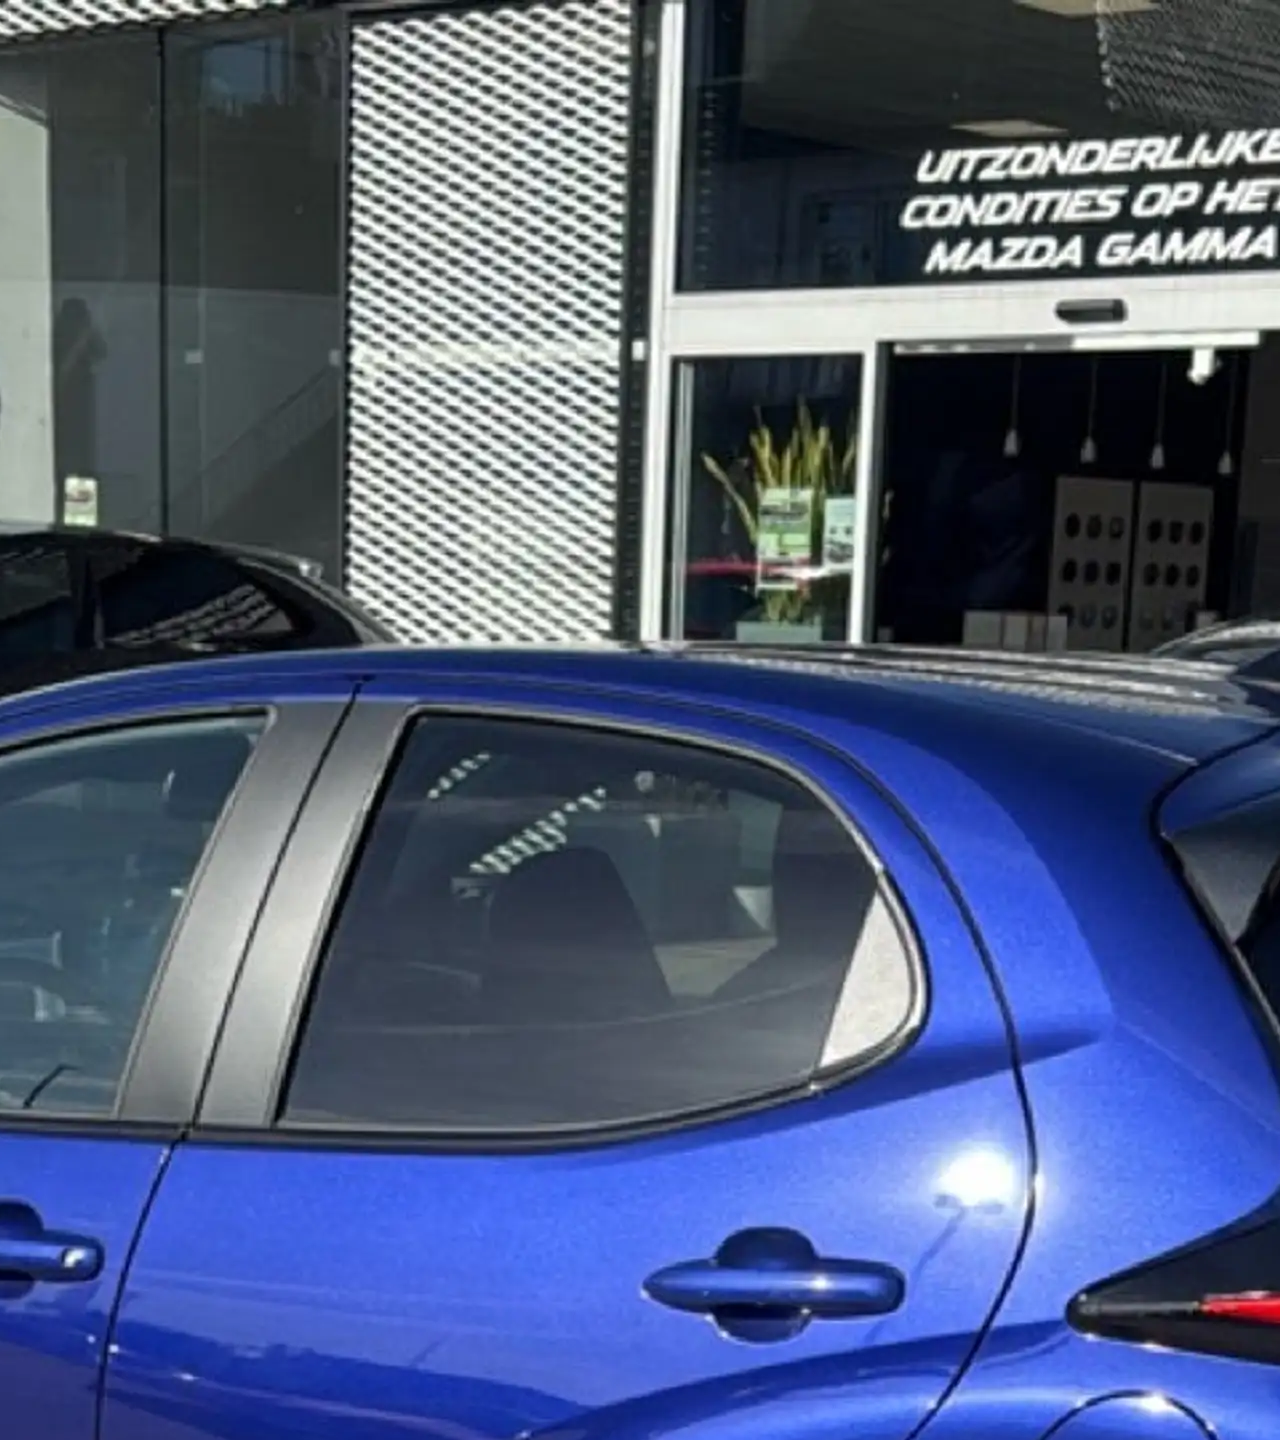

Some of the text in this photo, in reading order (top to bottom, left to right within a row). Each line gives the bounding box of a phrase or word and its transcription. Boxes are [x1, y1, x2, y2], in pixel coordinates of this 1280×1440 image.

[900, 187, 1129, 228] CONDITIES
[1130, 181, 1202, 219] OP
[924, 226, 1278, 273] MAZDA GAMMA
